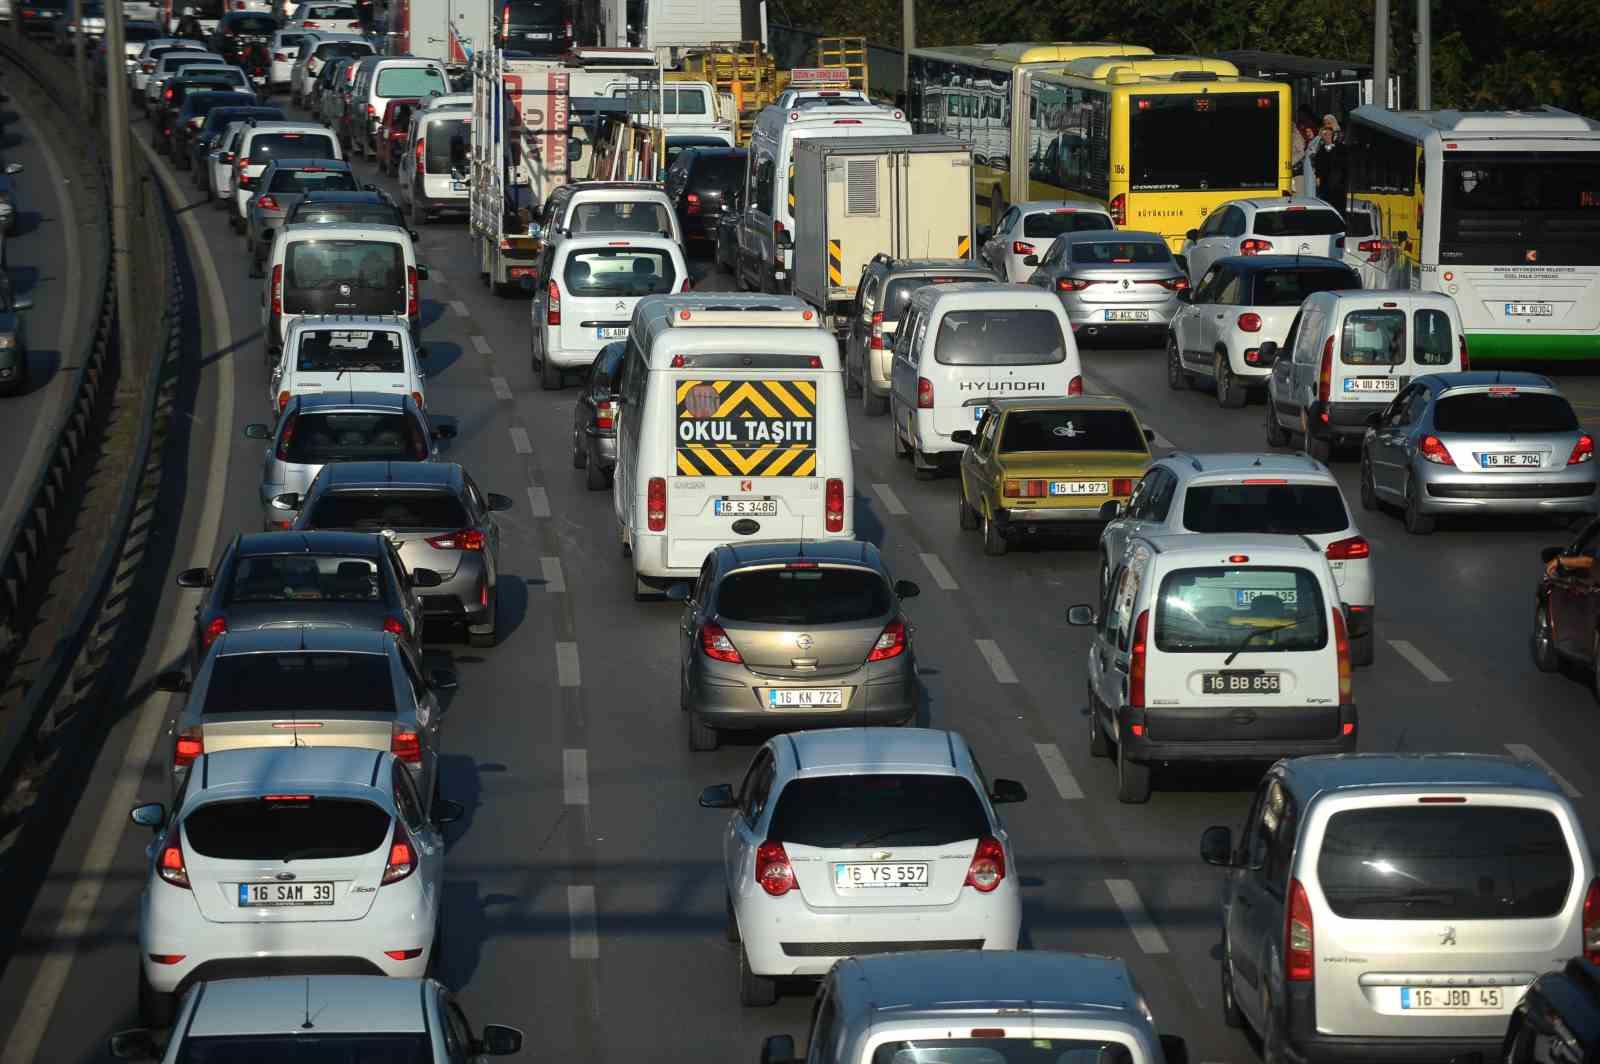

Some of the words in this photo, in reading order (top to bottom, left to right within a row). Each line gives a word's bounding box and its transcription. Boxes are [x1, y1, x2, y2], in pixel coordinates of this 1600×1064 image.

[960, 381, 1046, 391] HYUNDAI
[679, 421, 738, 441] OKUL
[744, 420, 813, 443] TAŞITI
[1487, 455, 1498, 464] 16
[1503, 455, 1516, 464] RE
[1521, 455, 1539, 464] 704
[1056, 484, 1066, 493] 16
[1071, 484, 1085, 492] LM
[1089, 483, 1106, 492] 973
[722, 502, 732, 512] 16
[737, 502, 745, 512] S
[749, 502, 775, 512] 3486
[1211, 676, 1224, 689] 16
[1231, 676, 1249, 689] BB
[780, 691, 792, 704] 16
[799, 691, 812, 704] KN
[819, 691, 839, 704] 722
[846, 866, 862, 881] 16
[870, 866, 891, 881] YS
[897, 866, 925, 880] 557
[252, 885, 268, 900] 16
[277, 885, 304, 900] SAM
[313, 885, 331, 900] 39
[1415, 990, 1432, 1006] 16
[1442, 990, 1470, 1006] JBD
[1480, 990, 1498, 1006] 45
